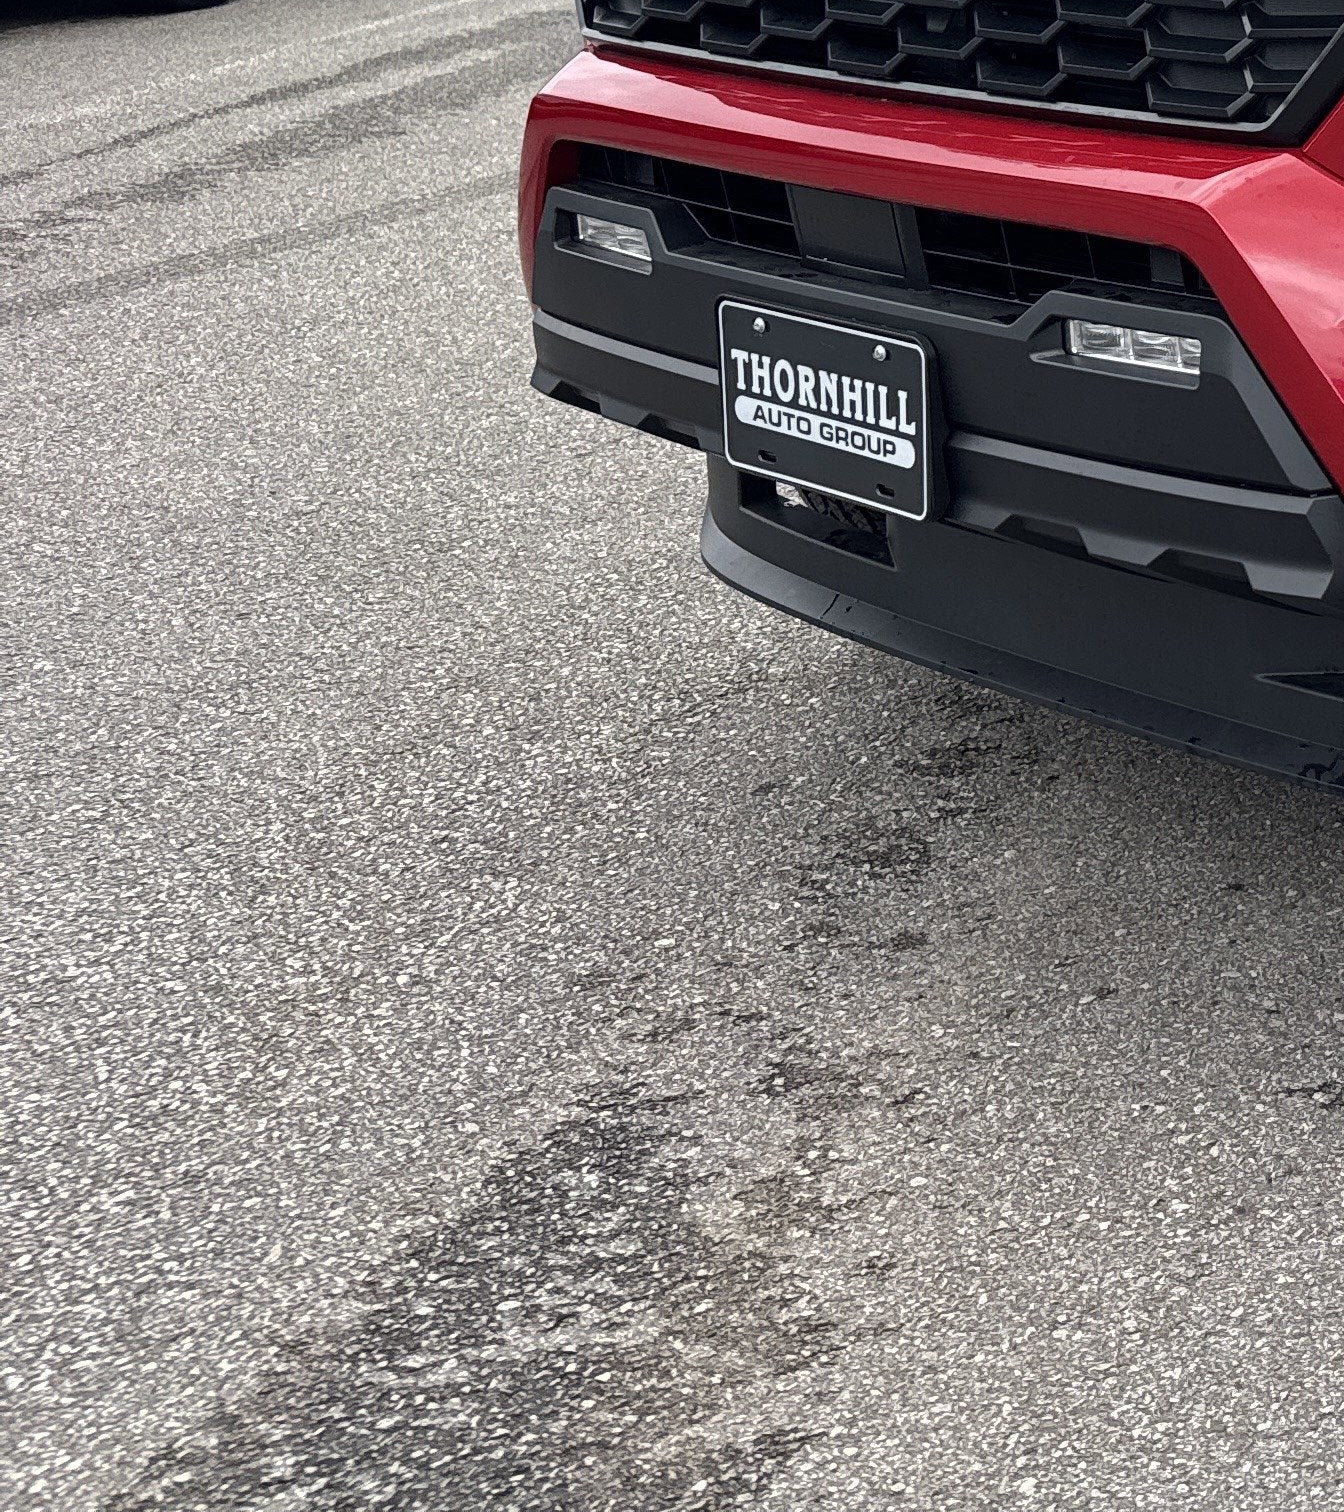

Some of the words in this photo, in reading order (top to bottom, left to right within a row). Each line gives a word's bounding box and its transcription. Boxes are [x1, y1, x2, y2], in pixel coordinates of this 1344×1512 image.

[731, 348, 916, 435] THORNHILL
[752, 405, 811, 436] AUTO
[819, 422, 896, 457] GROUP
